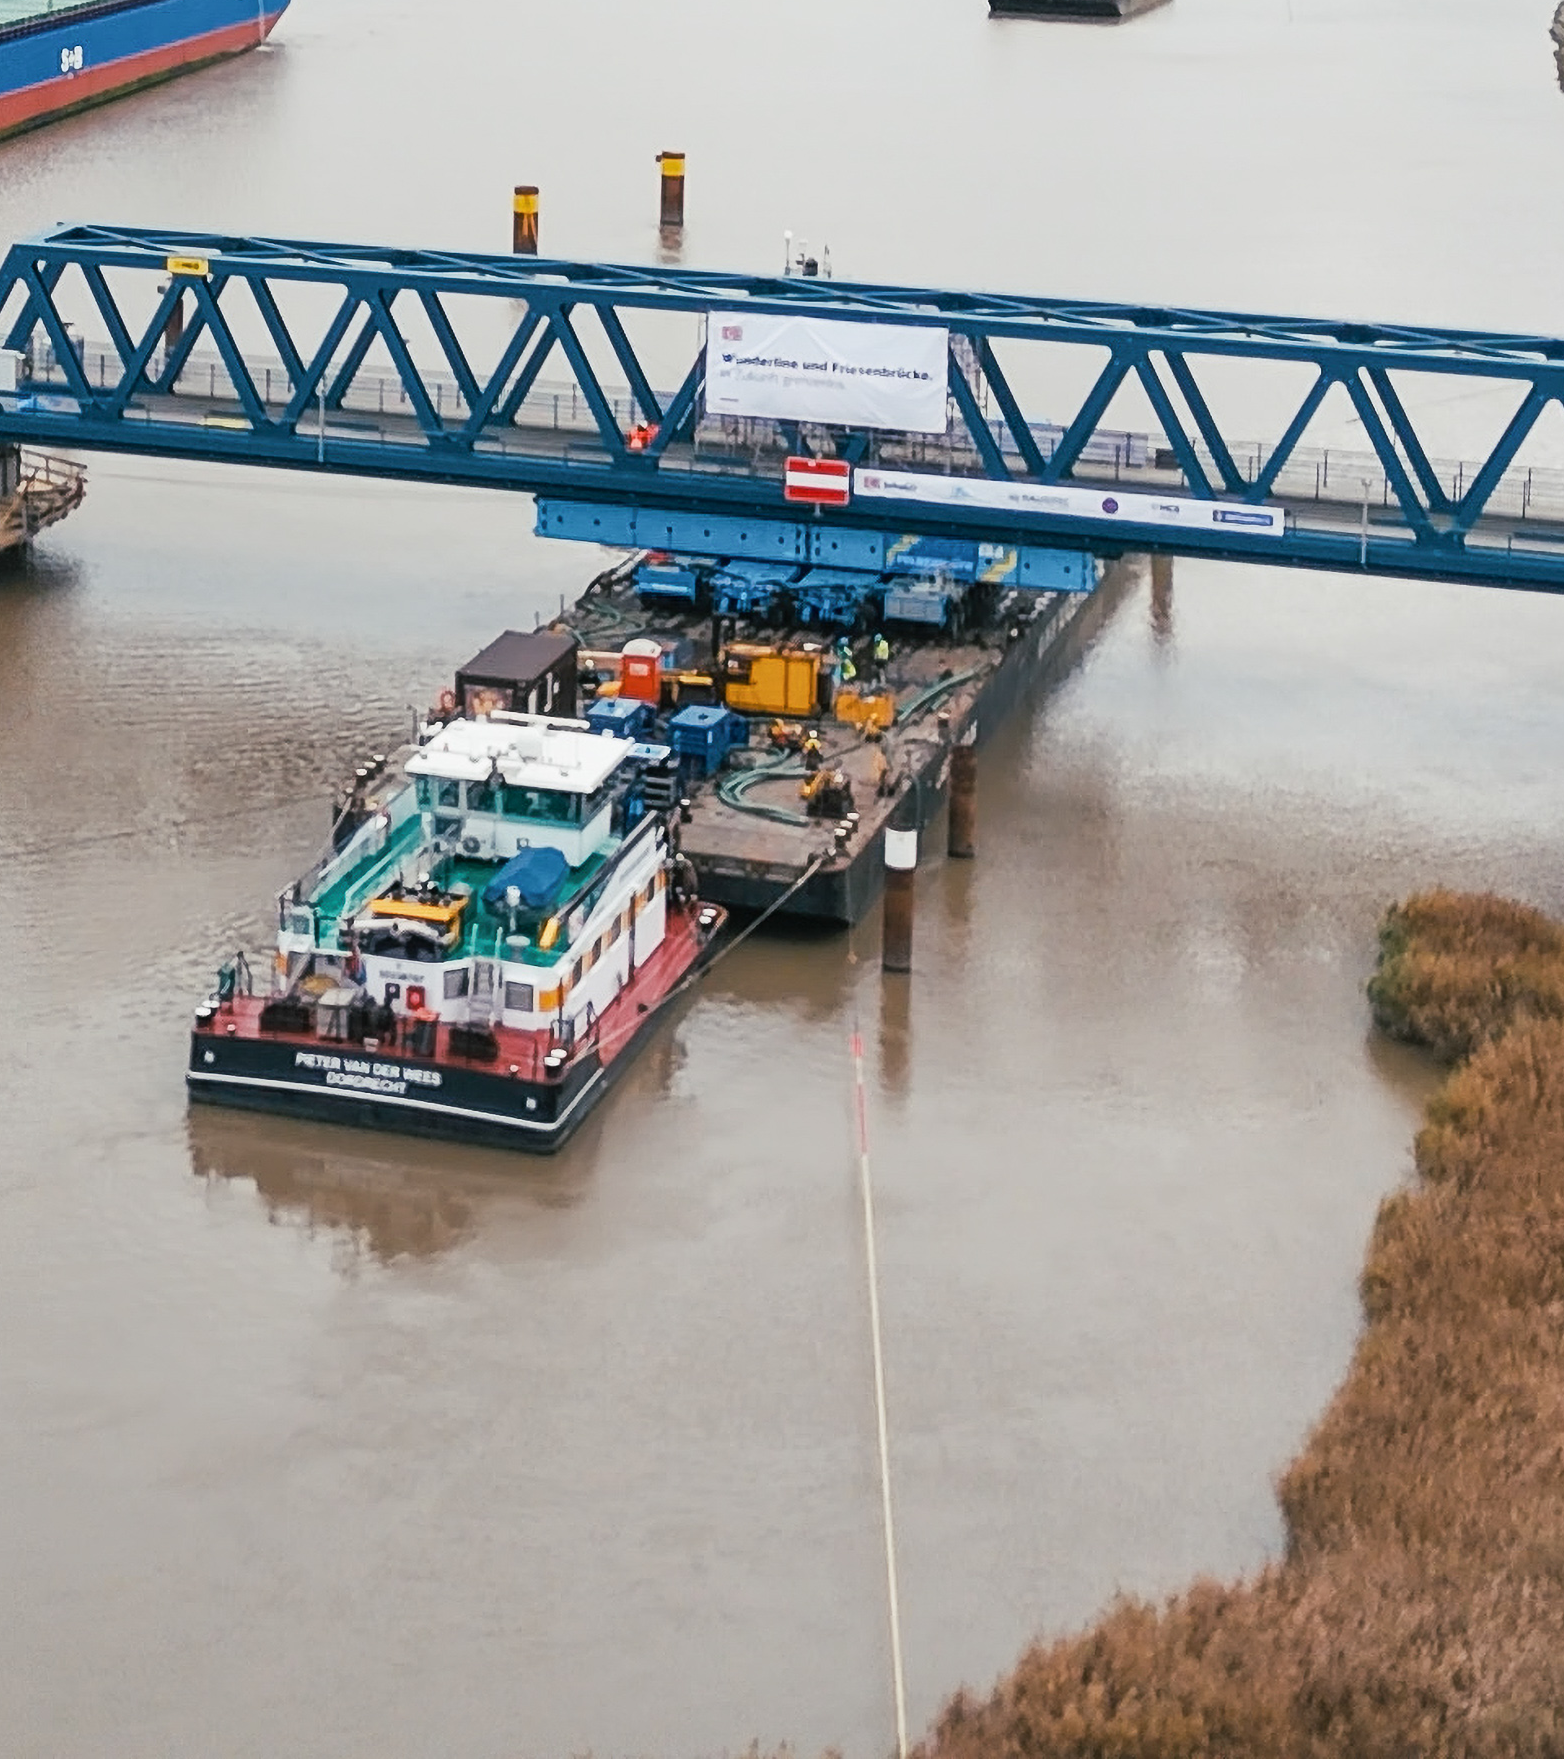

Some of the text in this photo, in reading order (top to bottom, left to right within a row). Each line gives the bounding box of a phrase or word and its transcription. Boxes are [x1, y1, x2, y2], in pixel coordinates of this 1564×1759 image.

[295, 1052, 341, 1069] PIETER
[343, 1059, 370, 1074] VAN
[372, 1063, 400, 1078] DER
